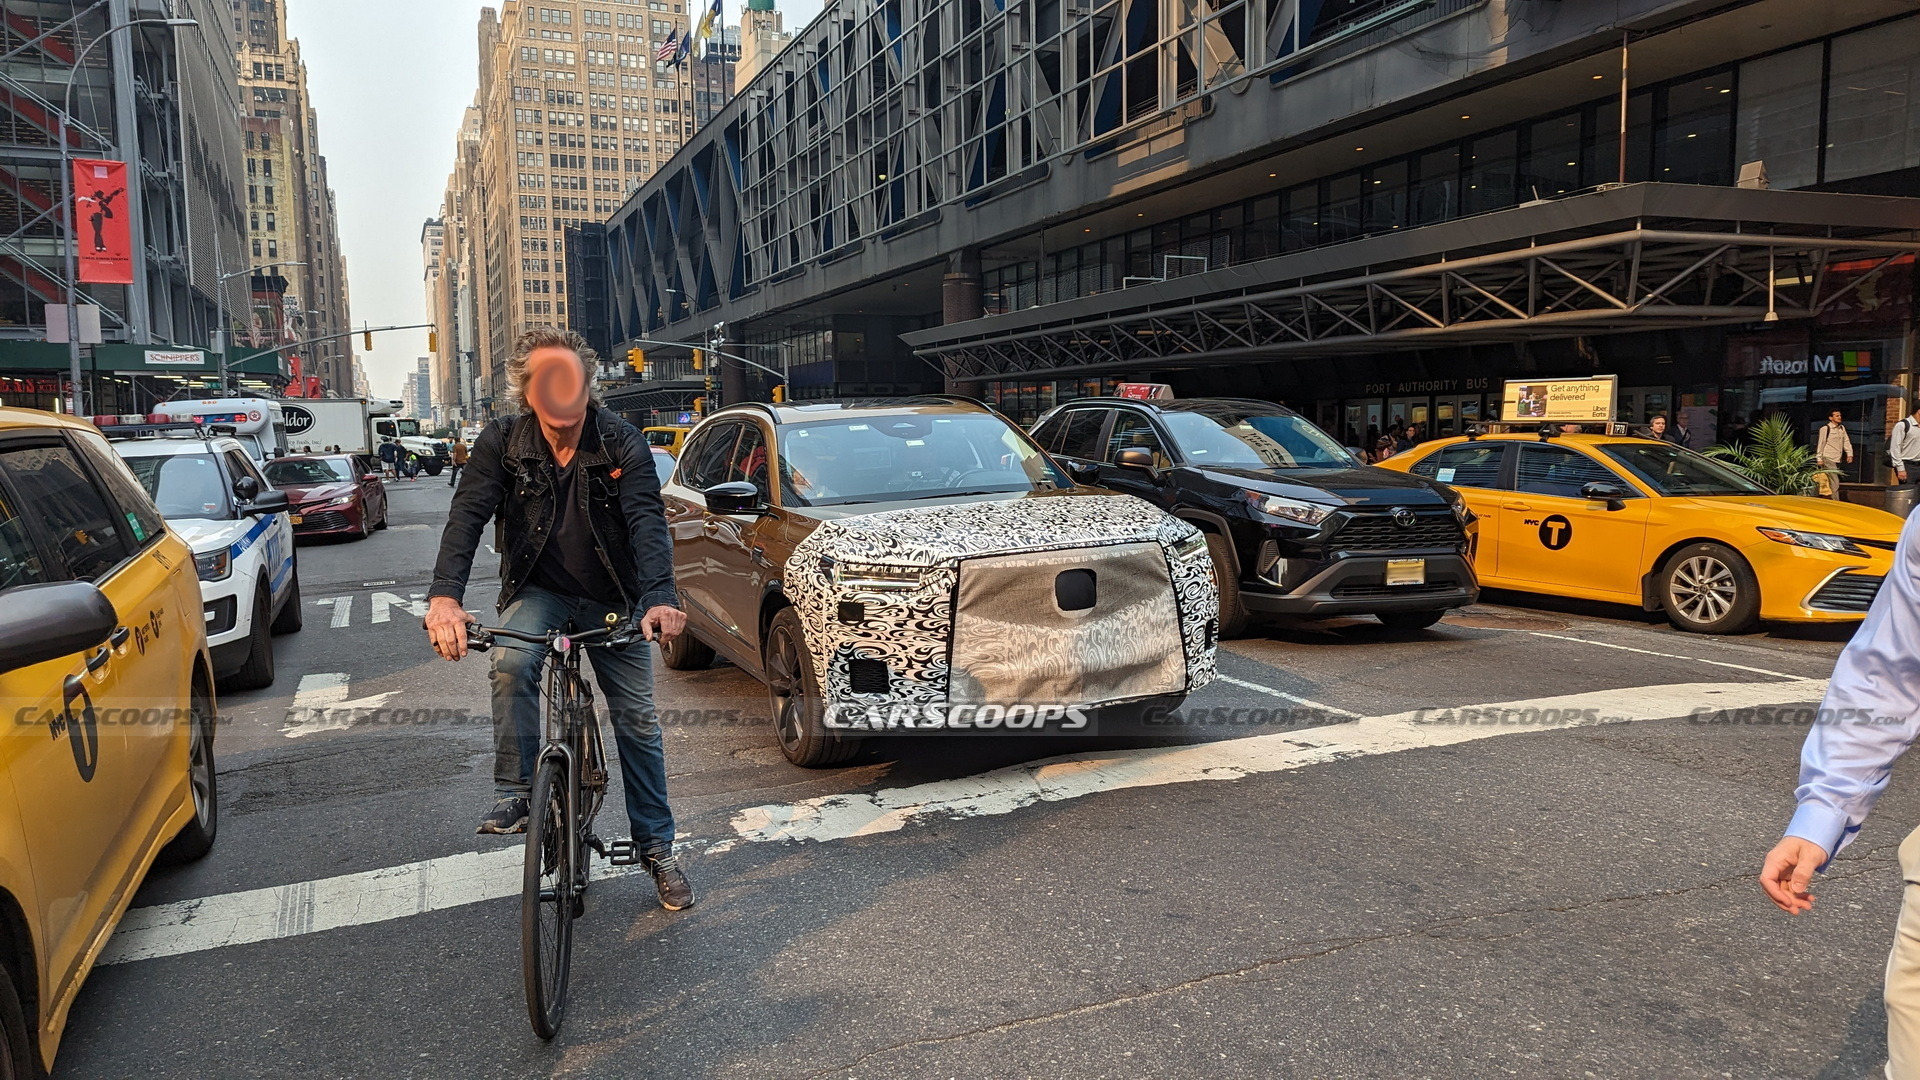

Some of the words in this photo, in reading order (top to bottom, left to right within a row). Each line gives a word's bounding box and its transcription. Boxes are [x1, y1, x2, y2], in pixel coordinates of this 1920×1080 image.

[1365, 383, 1391, 394] PORT
[1398, 380, 1458, 393] AUTHORITY
[1466, 378, 1488, 390] BUS
[1550, 384, 1565, 392] Get
[1566, 384, 1600, 395] anything
[1549, 393, 1586, 401] delivered
[1523, 518, 1540, 526] NYC
[48, 711, 66, 741] NYC
